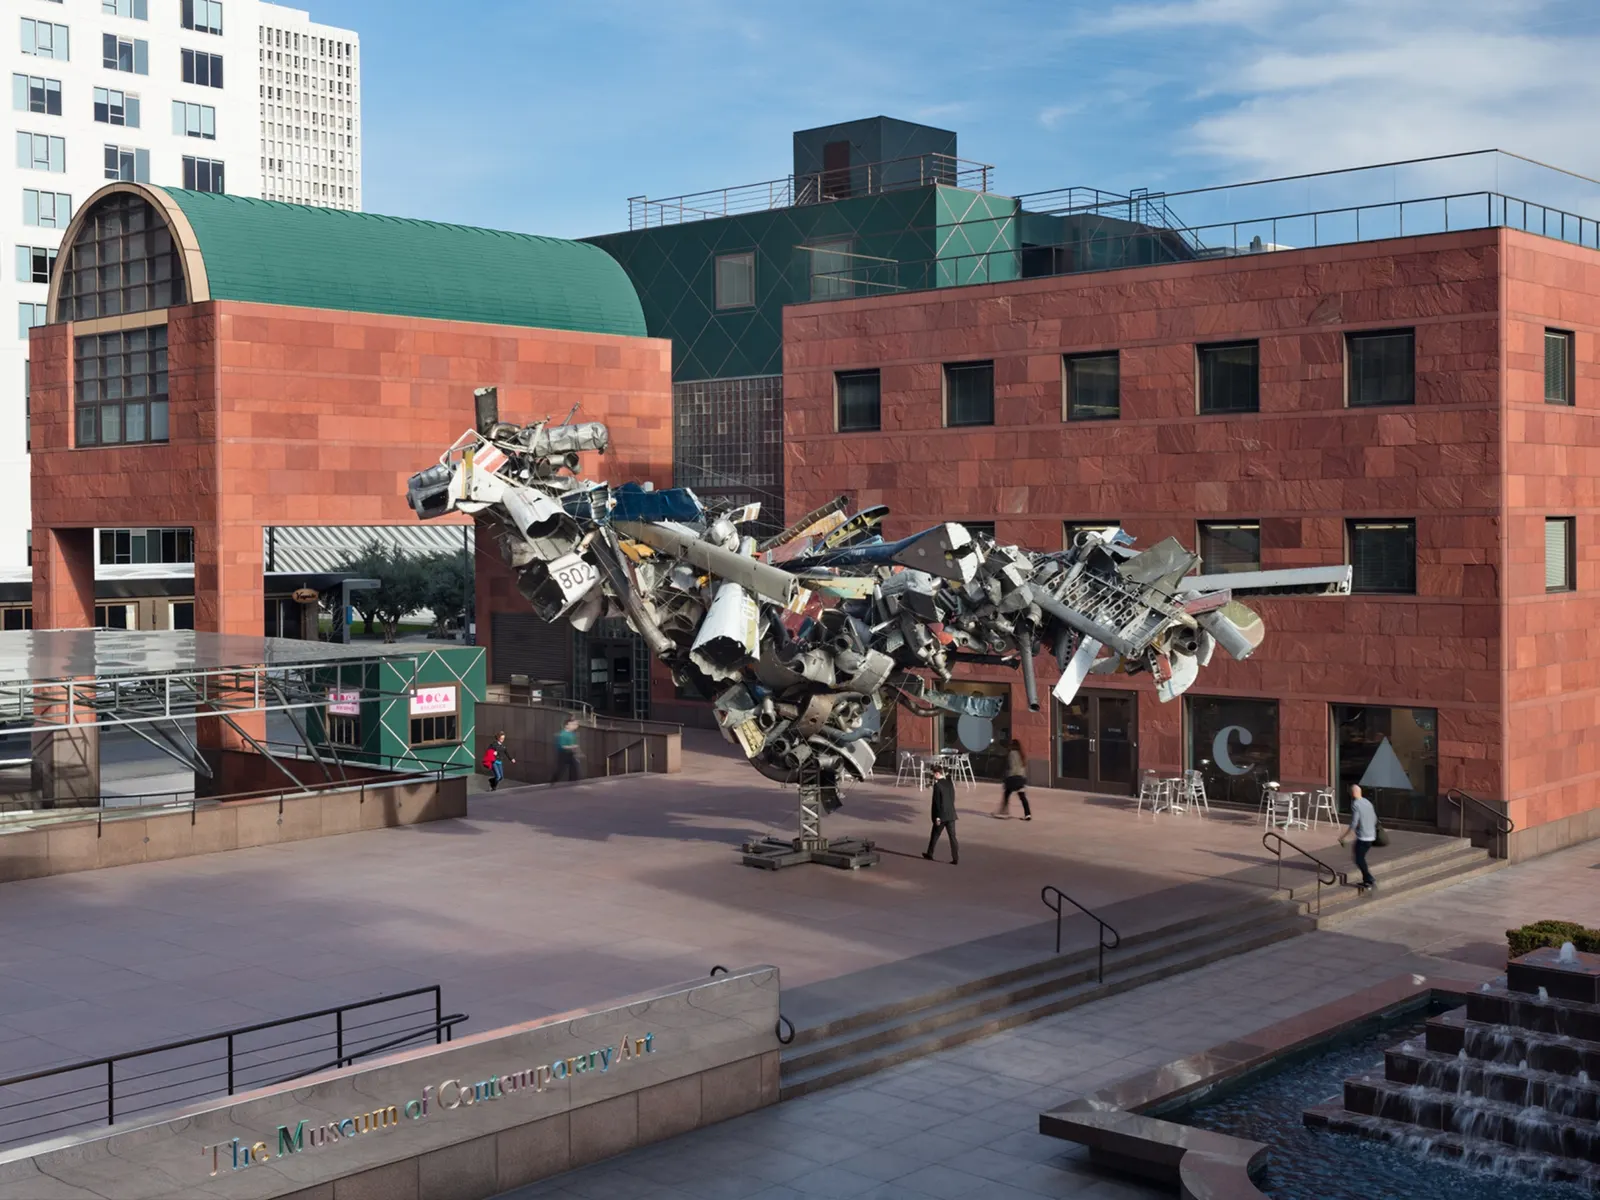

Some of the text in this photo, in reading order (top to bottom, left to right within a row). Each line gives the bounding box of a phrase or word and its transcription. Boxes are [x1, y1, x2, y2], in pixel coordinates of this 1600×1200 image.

[559, 564, 596, 589] 802
[201, 1031, 657, 1177] The Museum of Contemporary Art
